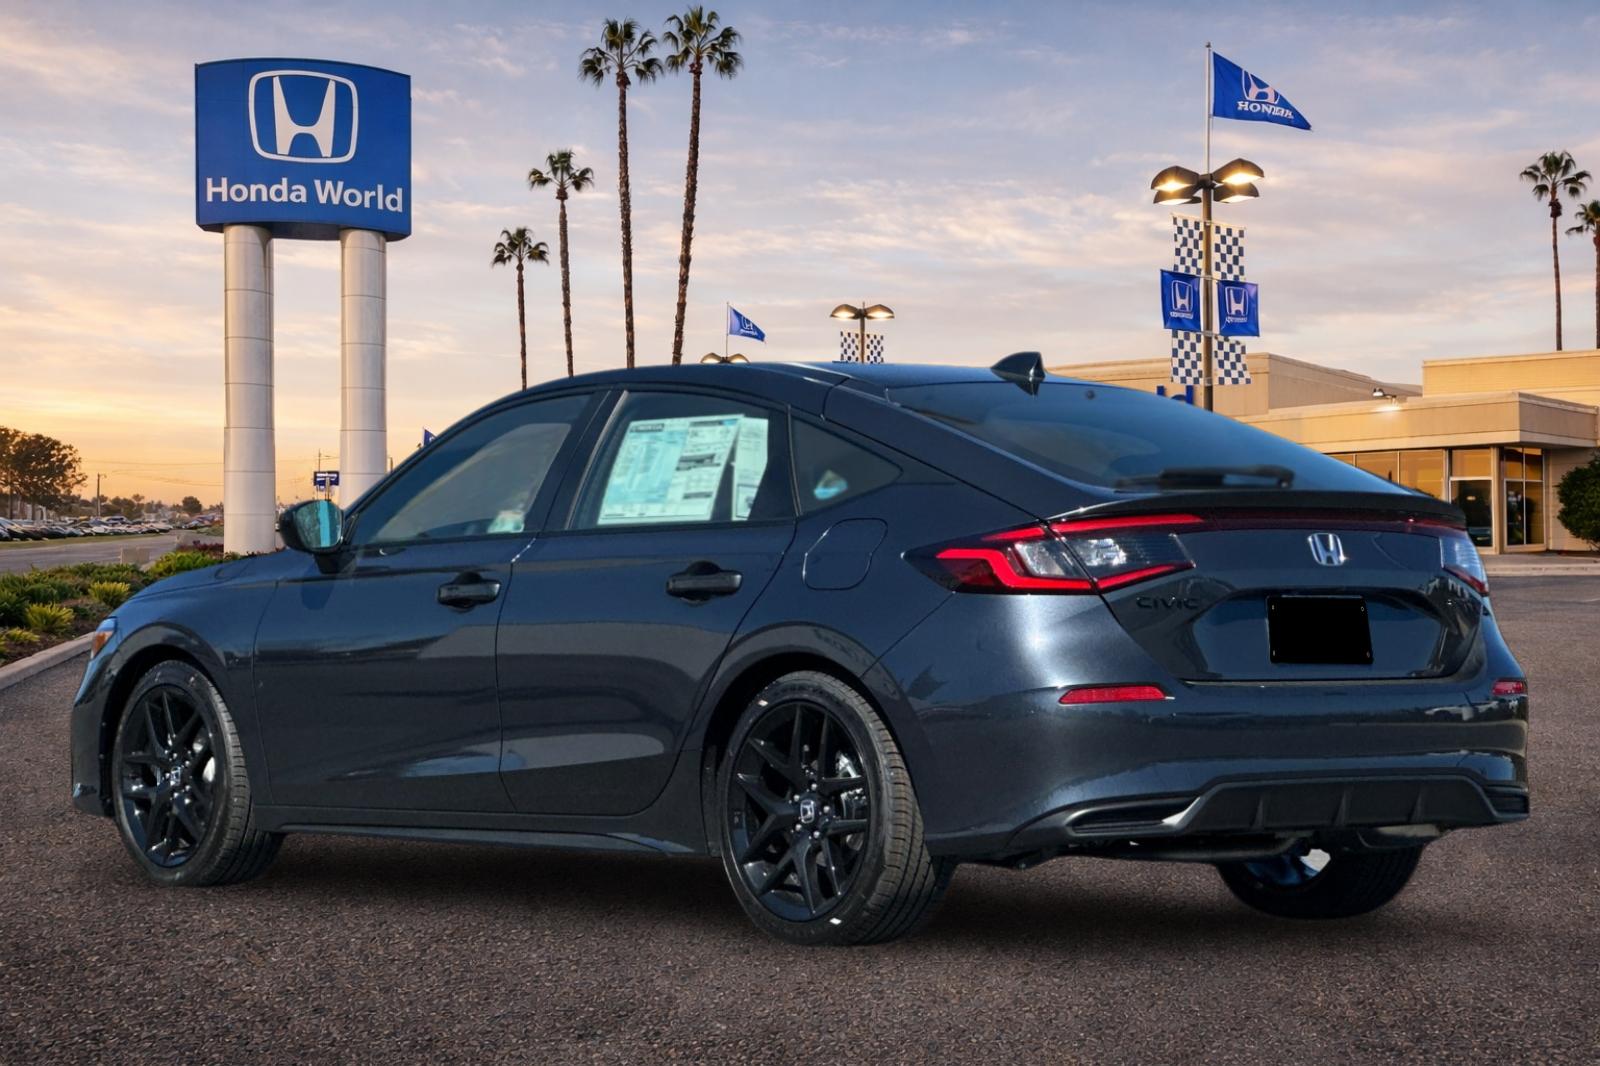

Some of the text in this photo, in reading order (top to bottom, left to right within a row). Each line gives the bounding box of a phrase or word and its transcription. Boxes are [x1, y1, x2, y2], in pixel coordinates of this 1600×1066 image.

[206, 177, 404, 213] Honda World
[1136, 596, 1199, 609] CIVIC
